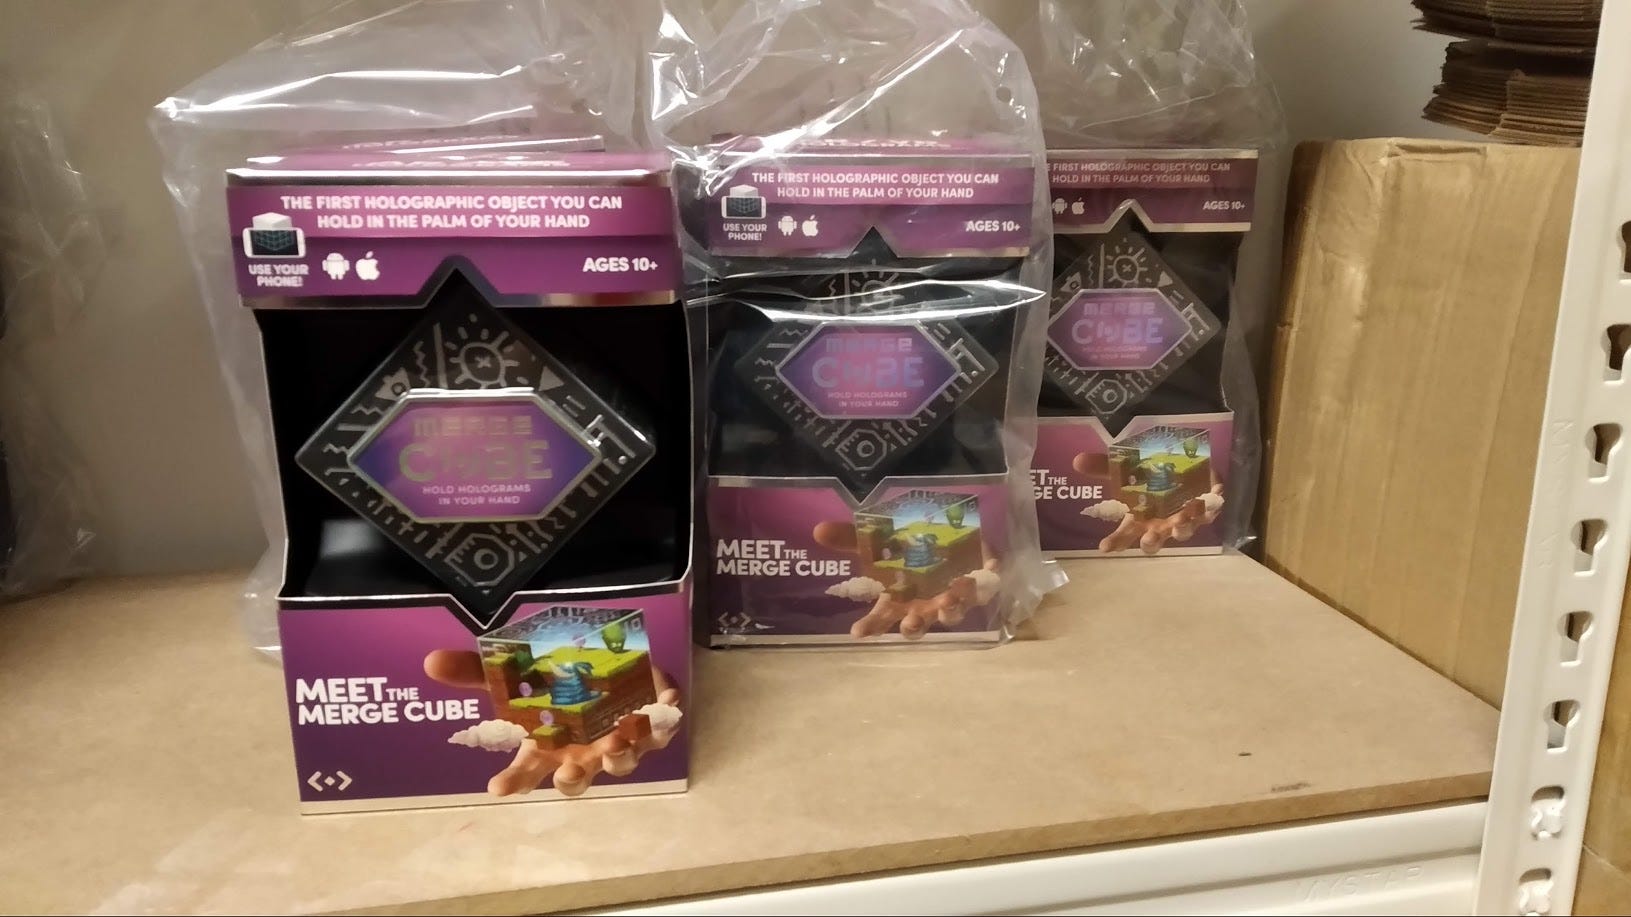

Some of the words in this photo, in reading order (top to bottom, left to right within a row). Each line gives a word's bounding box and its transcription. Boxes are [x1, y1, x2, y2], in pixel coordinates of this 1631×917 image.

[1053, 163, 1079, 171] FIRST
[751, 172, 775, 183] THE
[777, 172, 810, 183] FIRST
[812, 173, 899, 183] HOLOGRAPHIC
[901, 173, 945, 186] OBJECT
[946, 173, 972, 184] YOU
[974, 173, 1000, 184] CAN
[1052, 174, 1079, 183] HOLD
[1081, 174, 1091, 182] IN
[1092, 174, 1111, 183] THE
[1113, 174, 1139, 183] PALM
[1140, 174, 1153, 183] OF
[777, 187, 810, 197] HOLD
[812, 187, 825, 197] IN
[827, 187, 851, 197] THE
[852, 187, 885, 198] PALM
[887, 187, 903, 198] OF
[905, 187, 938, 198] YOUR
[940, 187, 974, 198] HAND
[280, 195, 313, 210] THE
[316, 195, 361, 209] FIRST
[364, 195, 485, 209] HOLOGRAPHIC
[487, 195, 548, 212] OBJECT
[550, 195, 585, 209] YOU
[588, 195, 622, 209] CAN
[1202, 200, 1230, 210] AGES
[1231, 200, 1246, 210] 10+
[317, 214, 364, 228] HOLD
[366, 214, 384, 228] IN
[386, 214, 419, 228] THE
[421, 214, 467, 228] PALM
[470, 214, 493, 228] OF
[495, 214, 541, 228] YOUR
[544, 214, 590, 228] HAND
[965, 220, 999, 233] AGES
[1001, 220, 1021, 232] 10+
[723, 223, 741, 232] USE
[743, 223, 767, 233] YOUR
[728, 232, 762, 241] PHONE!
[248, 264, 271, 275] USE
[272, 264, 309, 275] YOUR
[582, 256, 630, 272] AGES
[631, 256, 658, 271] 10+
[1047, 476, 1067, 485] THE
[422, 485, 455, 495] HOLD
[458, 484, 532, 495] HOLOGRAMS
[1056, 485, 1103, 499] CUBE
[438, 497, 452, 505] IN
[454, 496, 485, 506] YOUR
[488, 496, 520, 505] HAND
[716, 539, 786, 559] MEET
[783, 549, 808, 559] THE
[716, 559, 791, 576] MERGE
[795, 560, 851, 576] CUBE
[295, 677, 388, 703] MEET
[386, 687, 419, 700] THE
[298, 702, 399, 725] MERGE
[403, 699, 480, 722] CUBE
